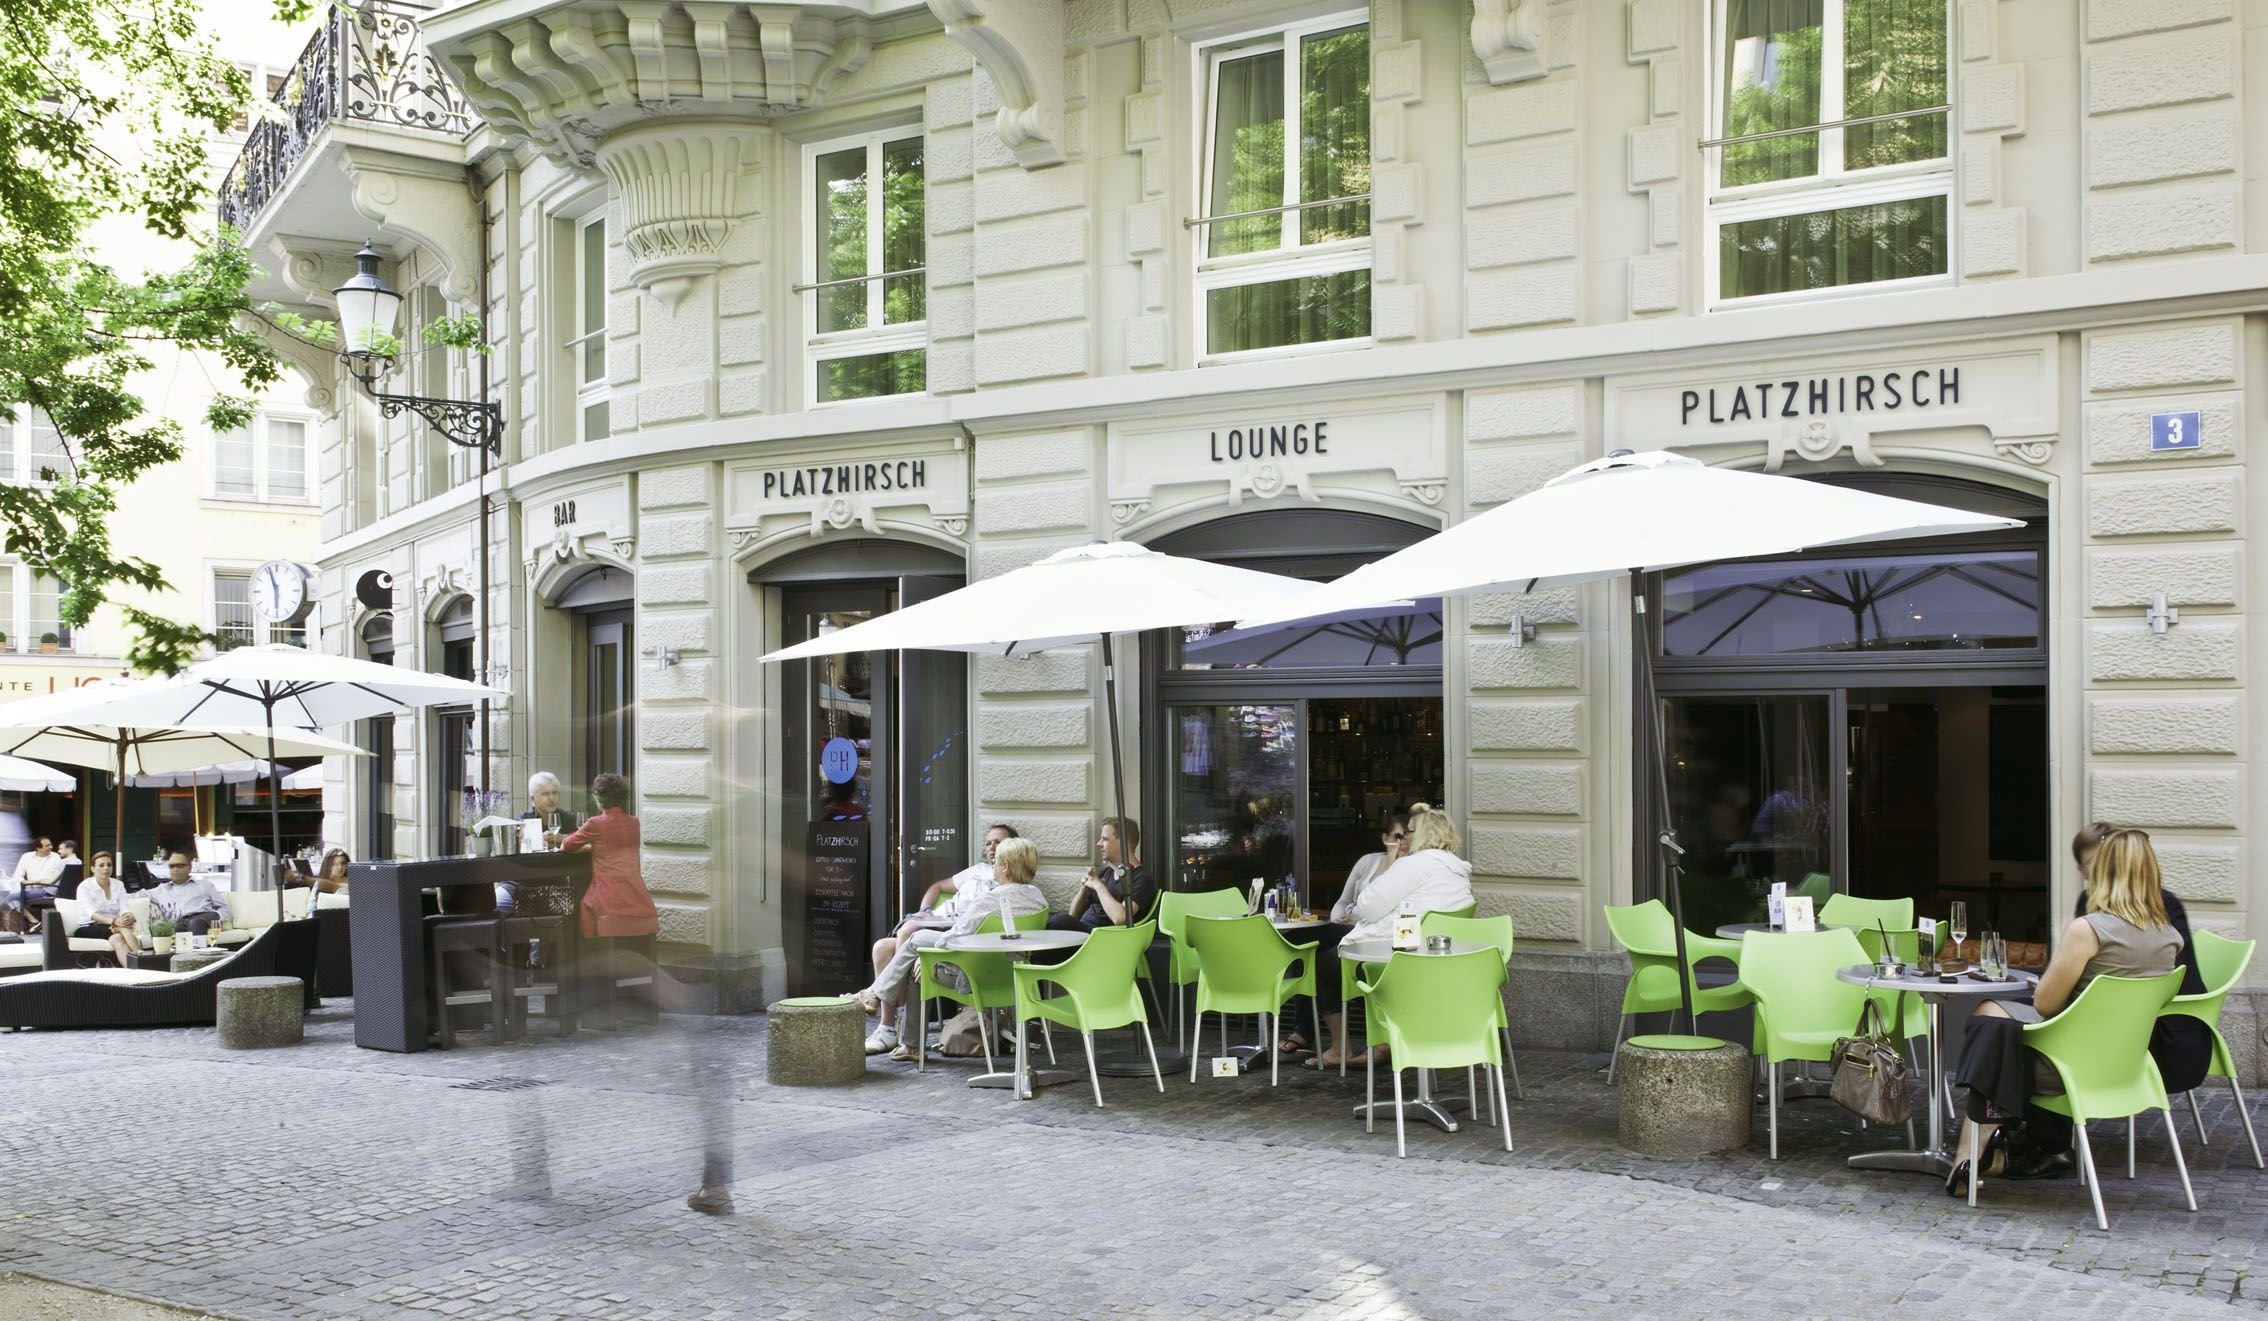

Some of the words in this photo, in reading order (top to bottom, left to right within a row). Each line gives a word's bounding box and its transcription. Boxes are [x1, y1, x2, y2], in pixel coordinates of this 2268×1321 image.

[1682, 367, 1959, 426] PLATZHIRSCH
[1211, 421, 1328, 462] LOUNGE
[2167, 417, 2183, 444] 3
[764, 460, 925, 499] PLATZHIRSCH
[554, 500, 576, 528] BAR
